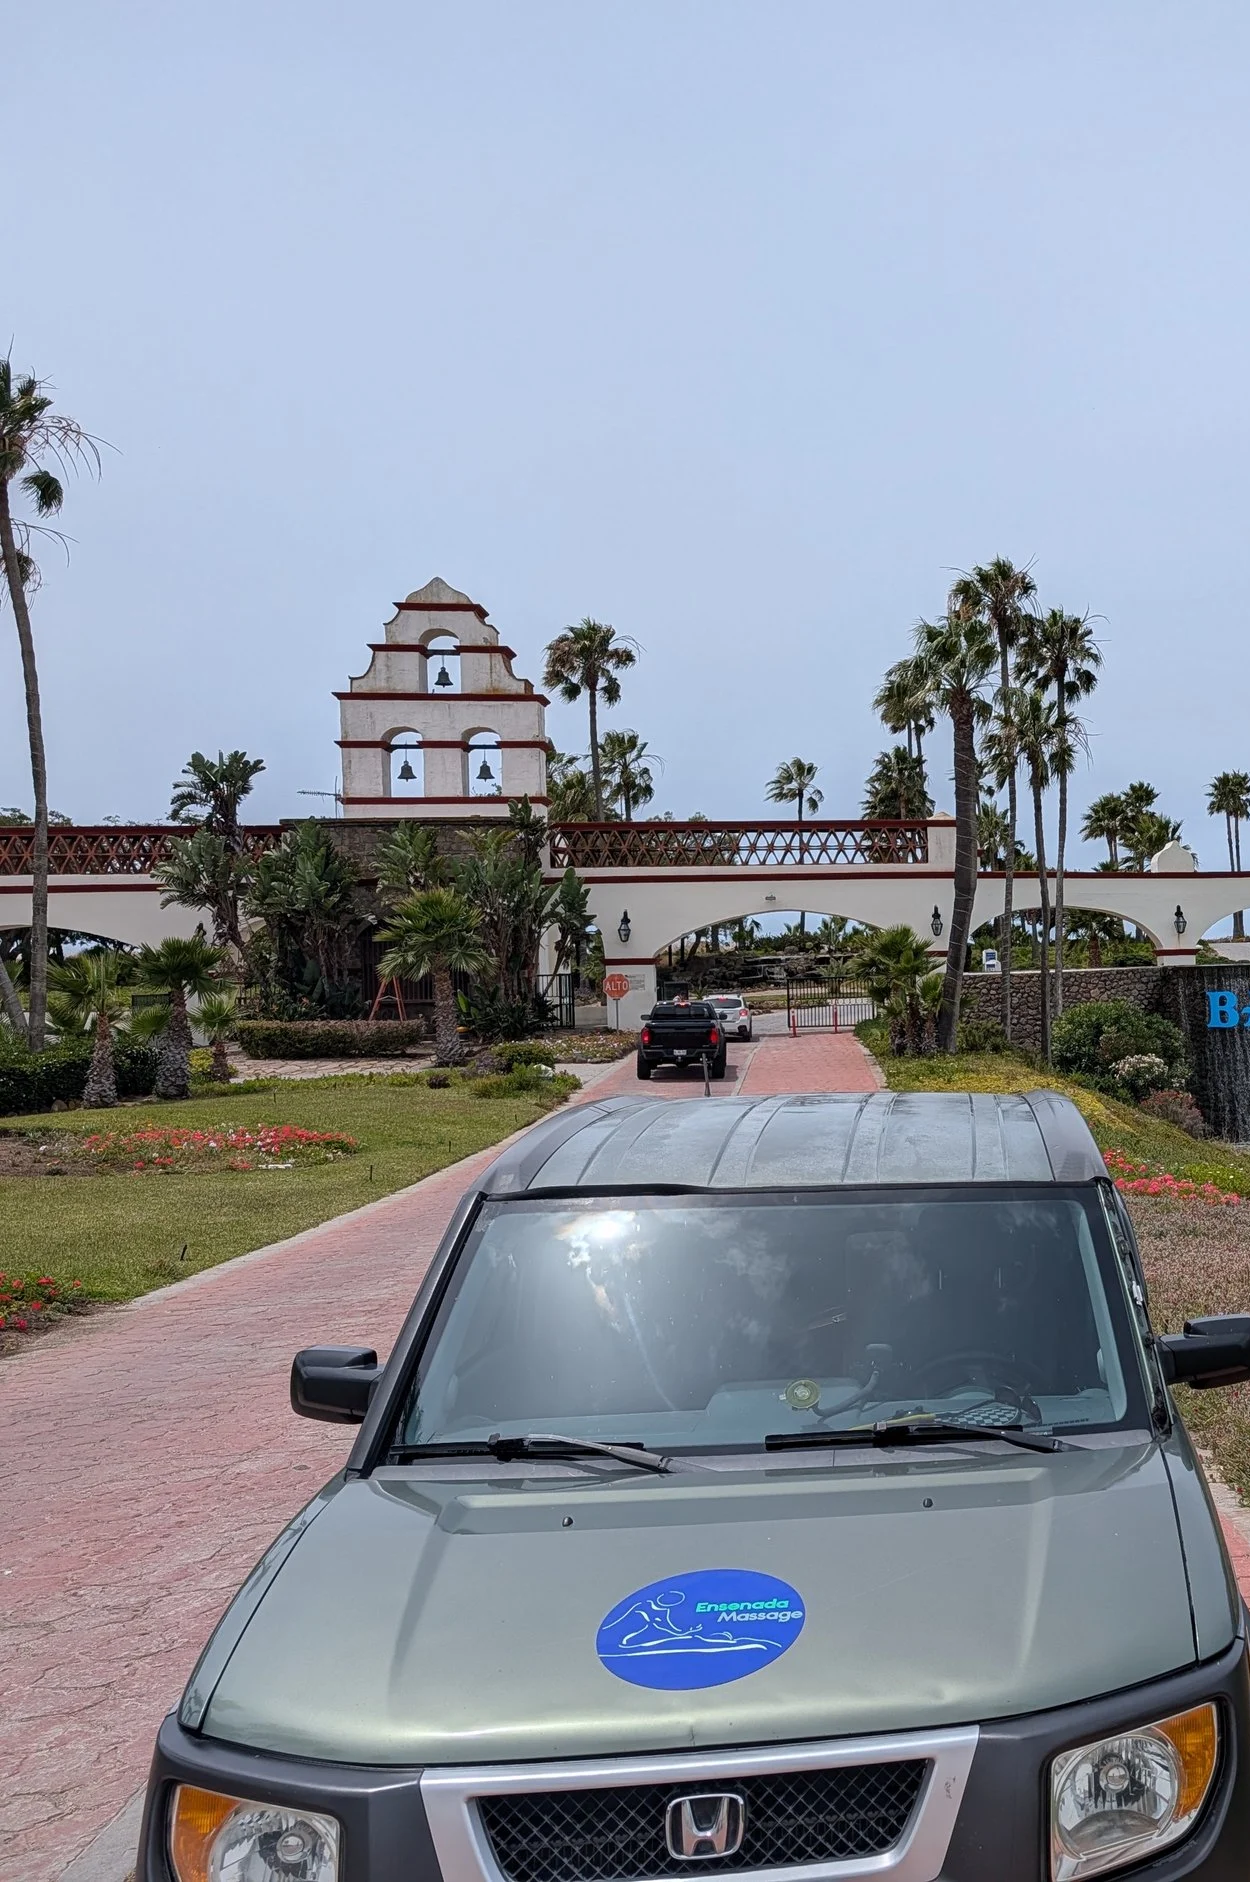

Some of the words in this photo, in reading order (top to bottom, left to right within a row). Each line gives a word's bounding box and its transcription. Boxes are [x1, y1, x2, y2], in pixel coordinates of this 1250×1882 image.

[605, 980, 629, 991] ALTO
[695, 1599, 790, 1614] Ensenada
[717, 1610, 803, 1624] Massage
